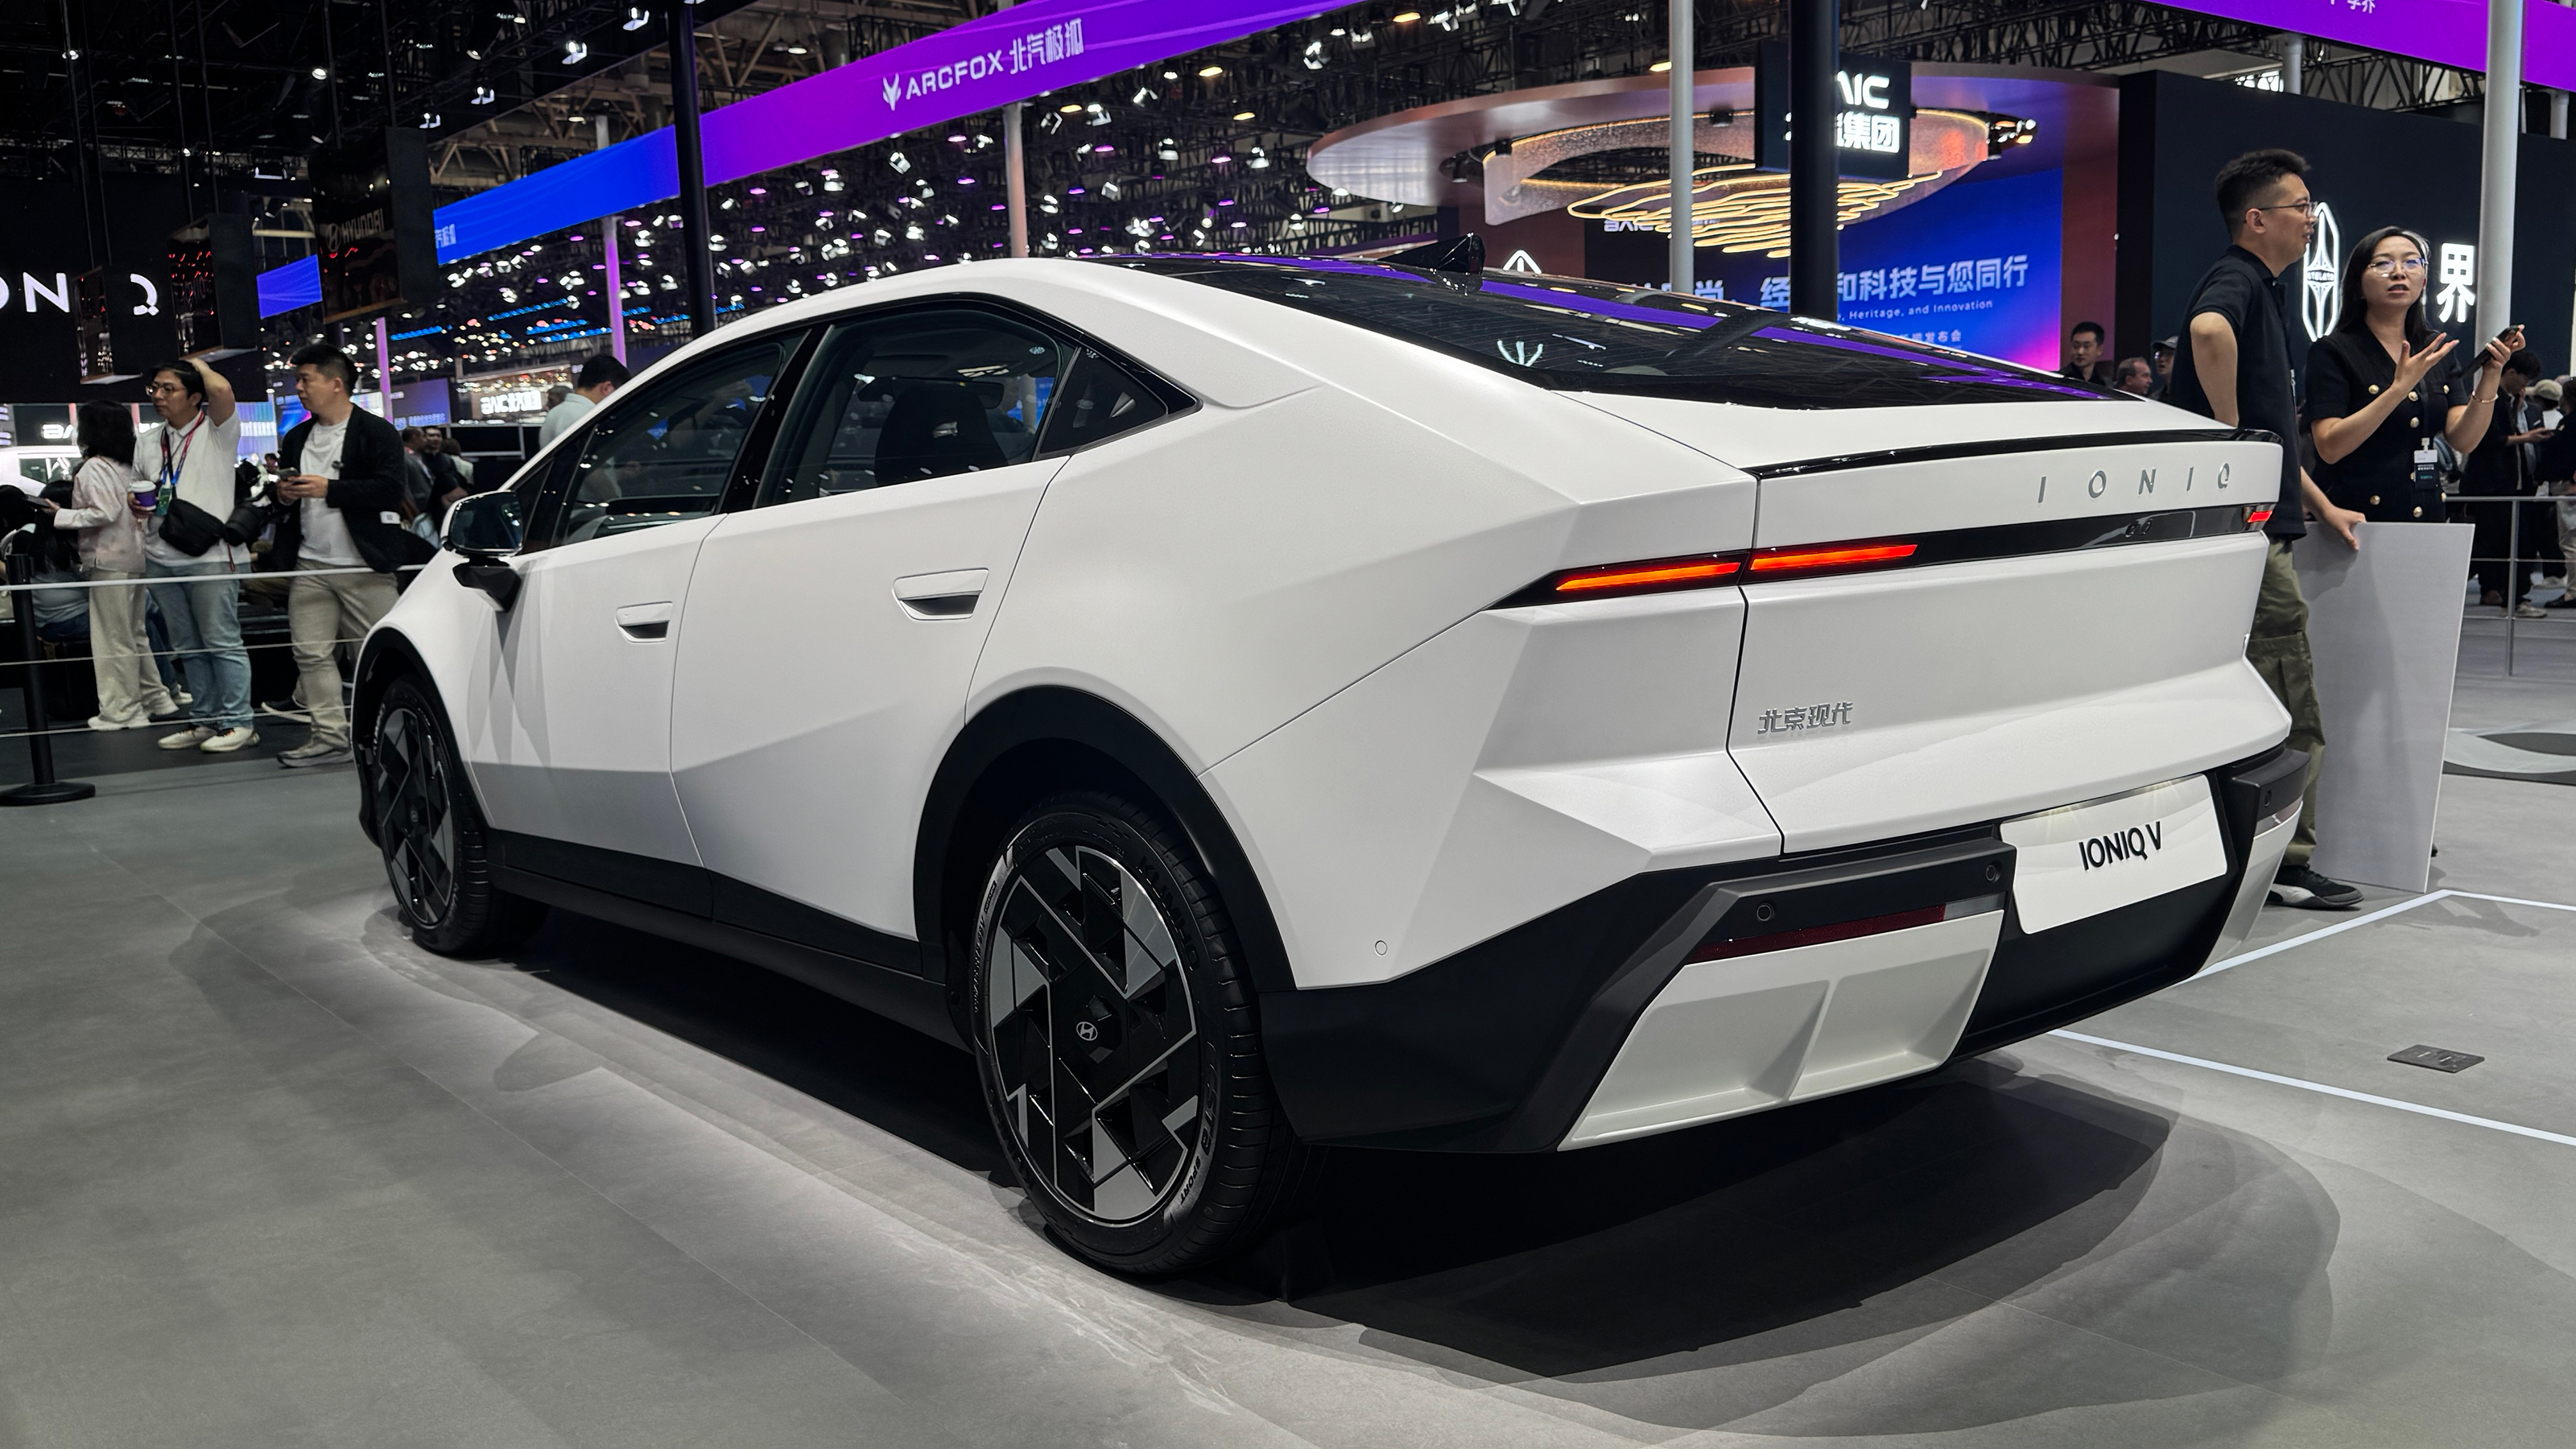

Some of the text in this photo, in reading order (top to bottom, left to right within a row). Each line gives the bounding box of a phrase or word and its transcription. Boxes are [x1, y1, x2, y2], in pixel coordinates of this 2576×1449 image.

[1009, 18, 1084, 75] 北汽极狐
[906, 49, 1004, 100] ARCFOX
[1836, 70, 1890, 109] AIC
[341, 208, 385, 244] HYUNDAI
[2436, 242, 2476, 324] 界
[1849, 308, 1904, 320] Heritage,
[1908, 304, 1930, 316] and
[1933, 299, 1993, 313] Innovation
[2037, 462, 2231, 504] IONIQ
[1757, 700, 1854, 734] 北京现代
[2078, 820, 2161, 871] IONIQ V
